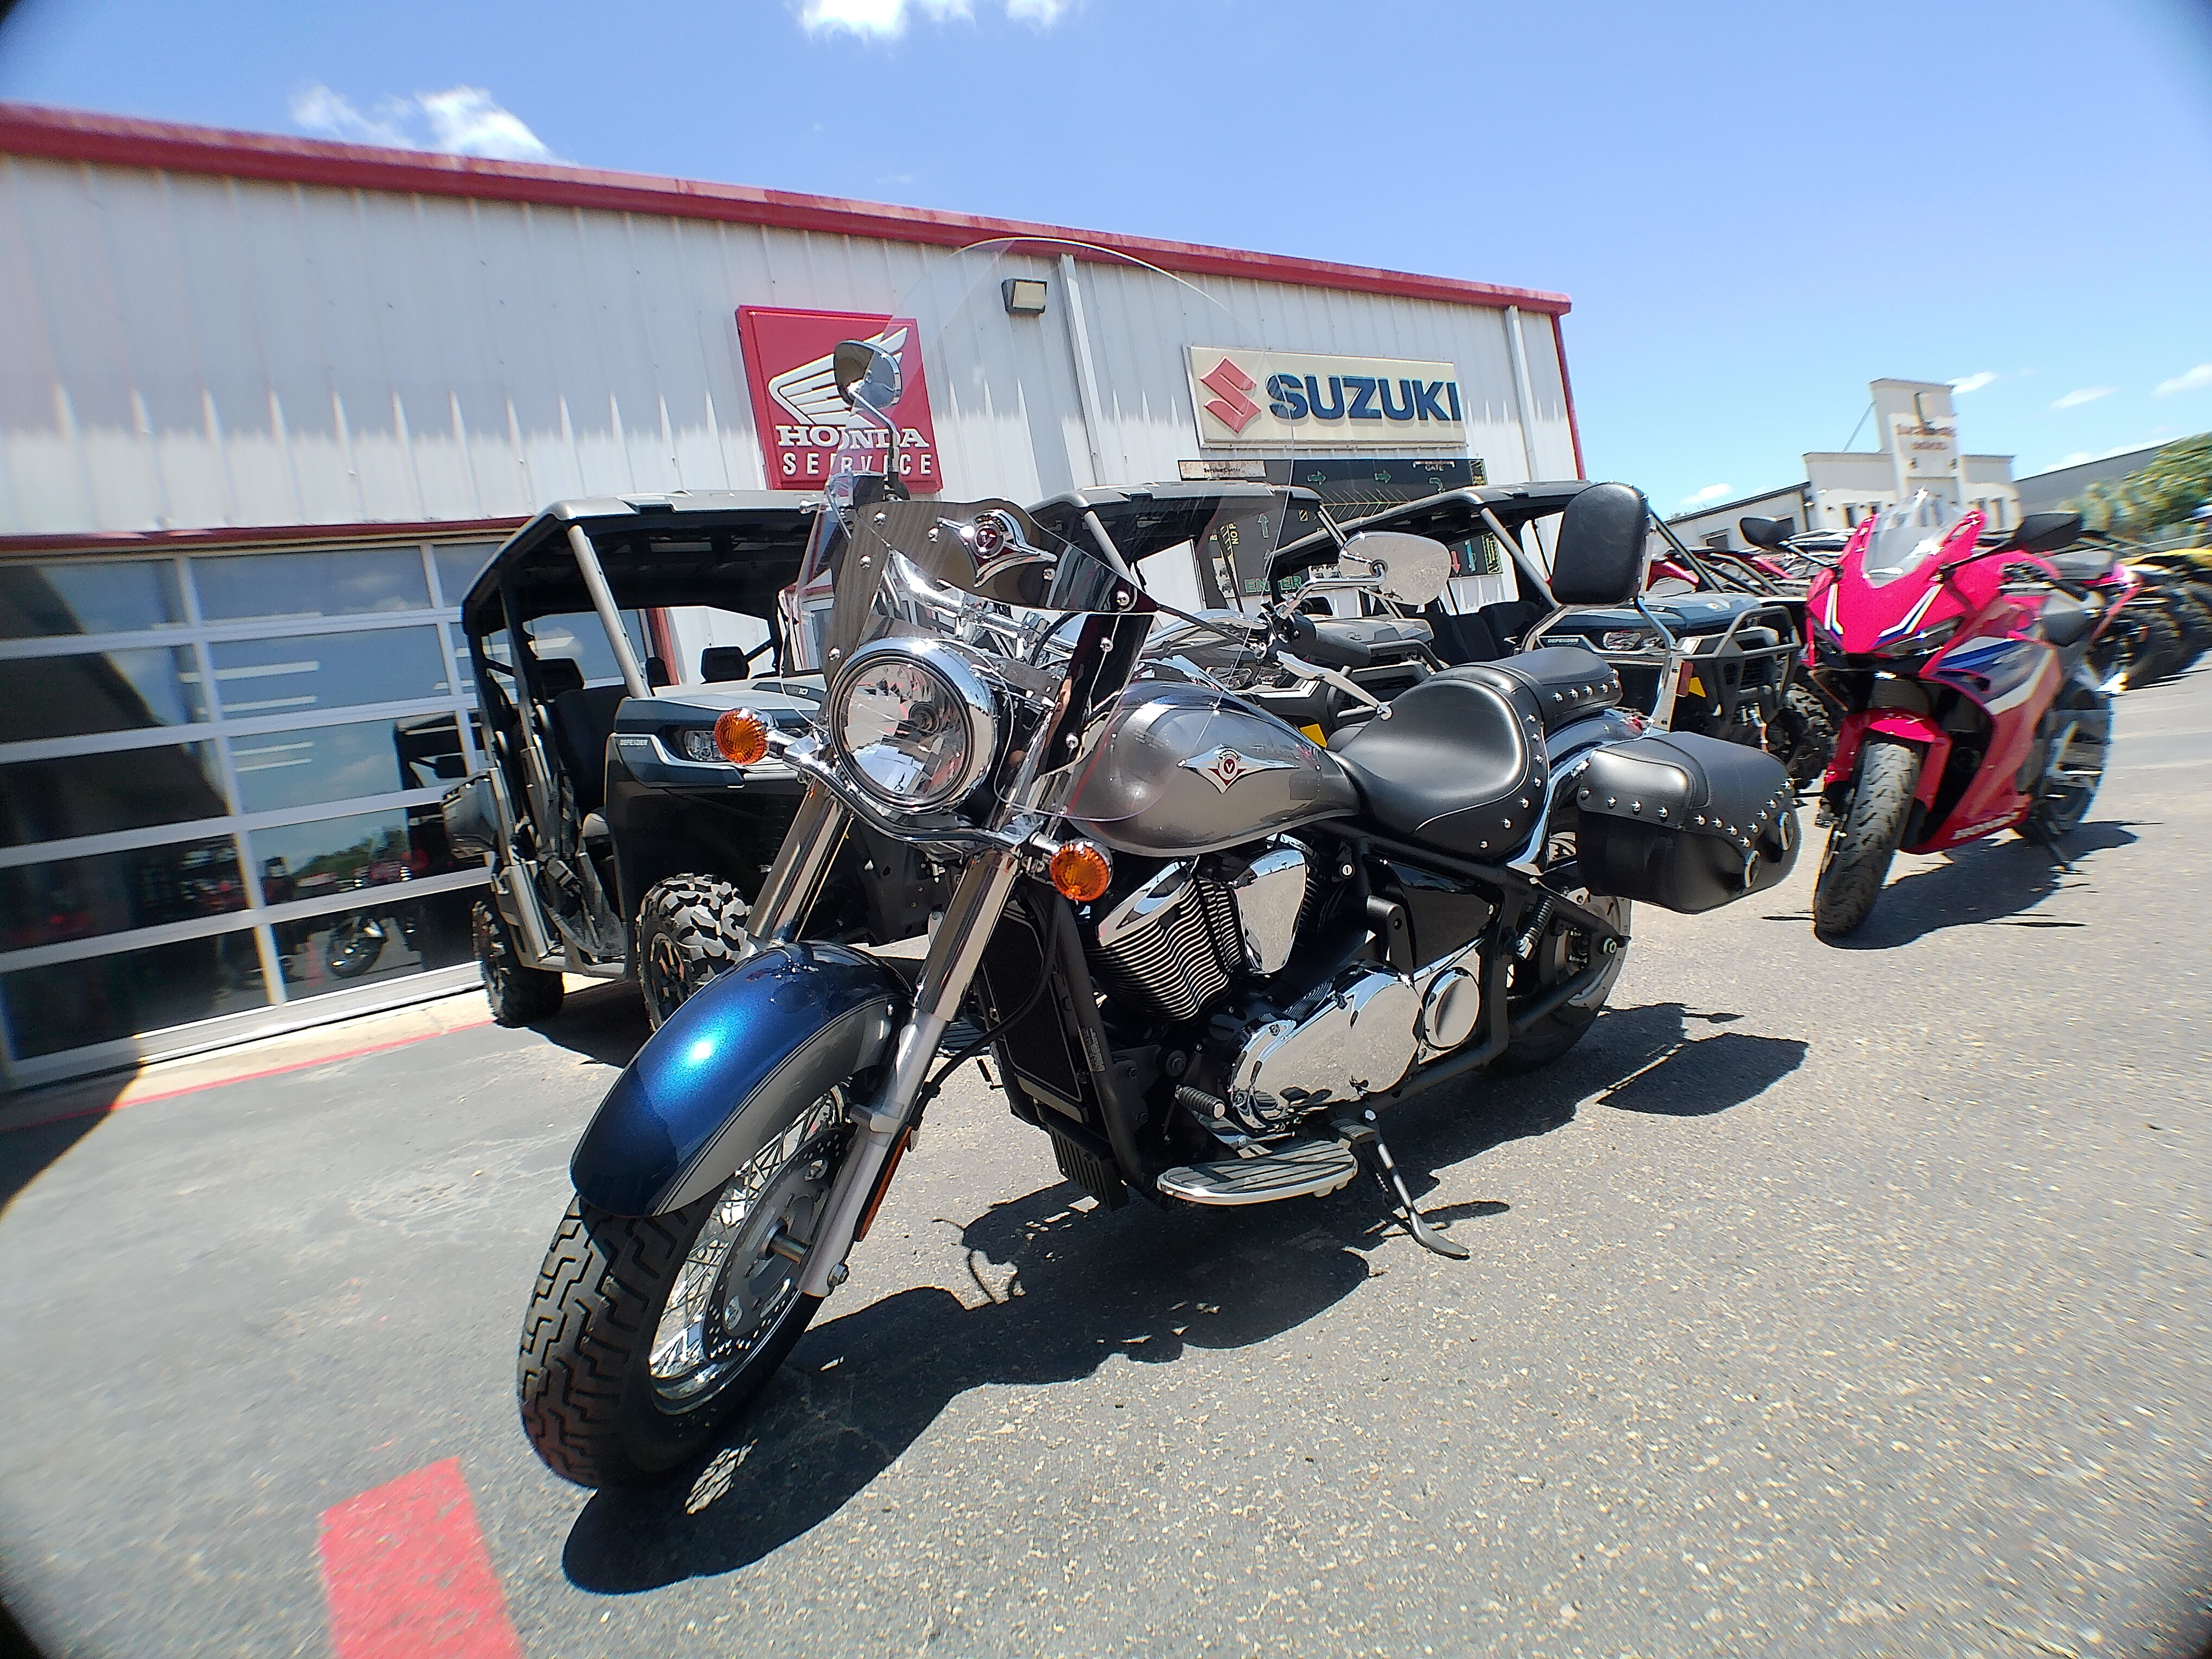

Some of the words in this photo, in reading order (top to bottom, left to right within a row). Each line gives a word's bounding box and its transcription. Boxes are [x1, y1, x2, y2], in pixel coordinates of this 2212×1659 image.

[1265, 373, 1462, 421] SUZUKI
[775, 425, 929, 450] HONDA
[782, 453, 931, 475] SERVICE
[1230, 531, 1239, 544] NO
[1244, 576, 1302, 593] ENER
[1225, 763, 1233, 773] V
